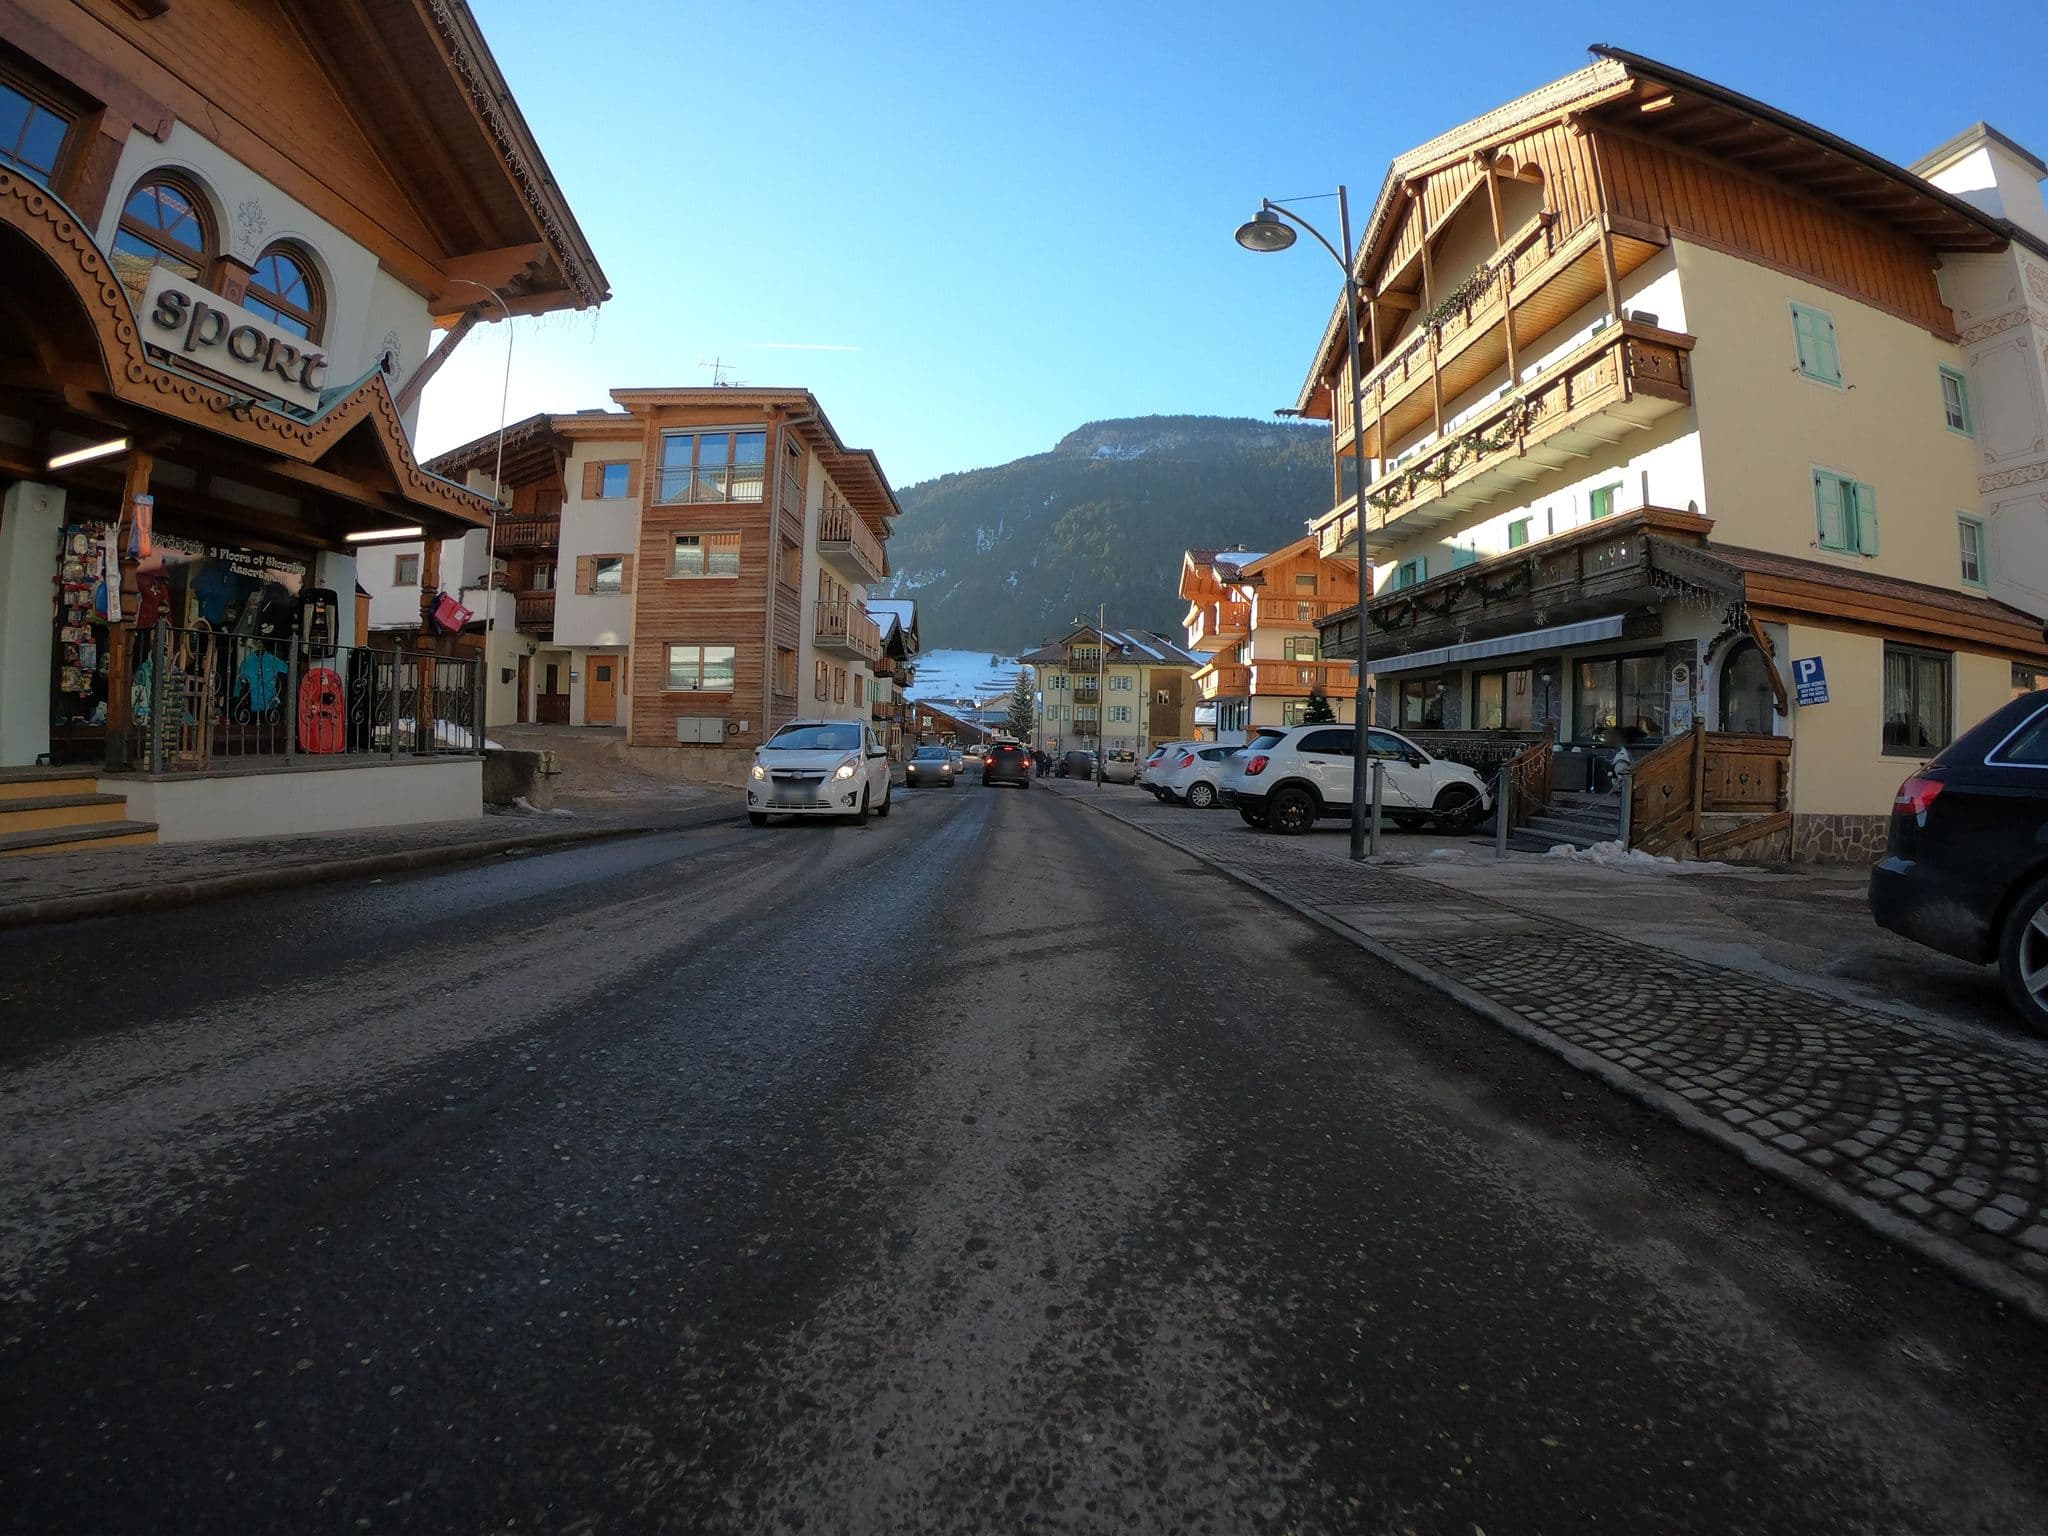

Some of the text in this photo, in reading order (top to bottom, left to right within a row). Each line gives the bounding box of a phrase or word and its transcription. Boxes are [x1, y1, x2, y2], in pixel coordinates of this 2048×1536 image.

[210, 547, 306, 577] 3 Floors of Shopping
[1799, 659, 1816, 682] P
